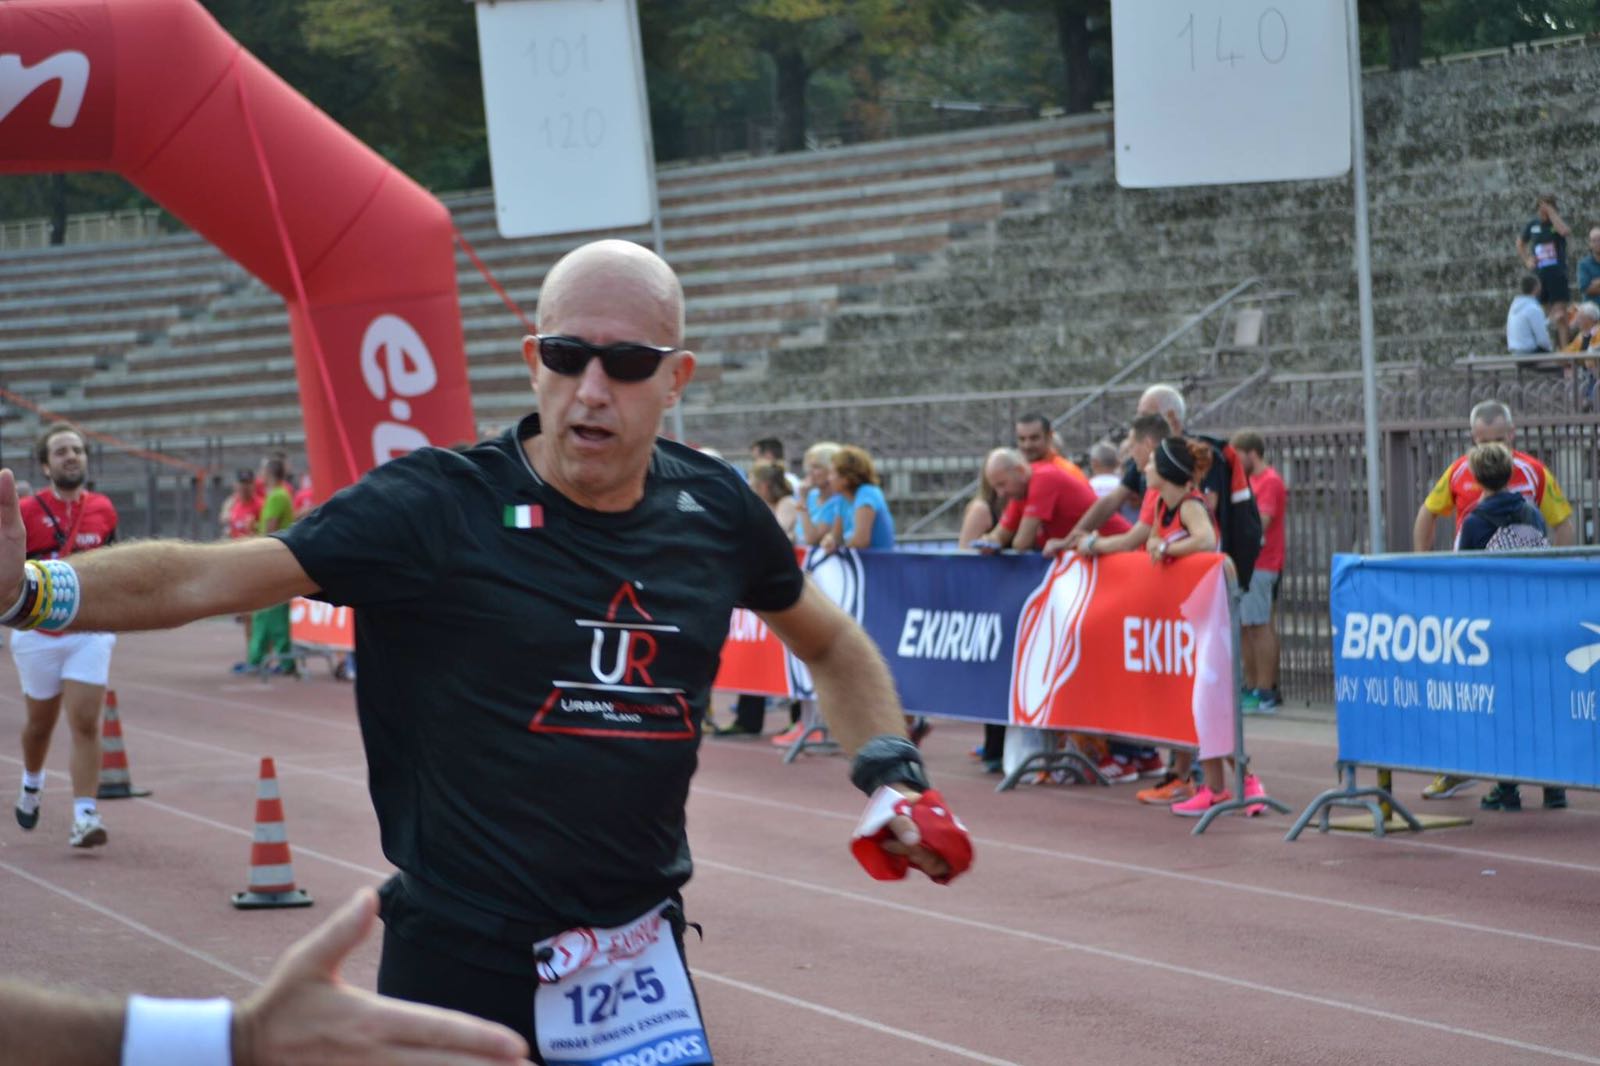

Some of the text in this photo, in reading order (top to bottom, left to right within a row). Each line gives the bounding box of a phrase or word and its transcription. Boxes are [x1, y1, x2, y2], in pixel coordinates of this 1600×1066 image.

[522, 33, 592, 78] 101
[1177, 6, 1289, 72] 140
[538, 107, 606, 149] 120
[590, 628, 659, 686] UR
[1340, 612, 1491, 667] BROOKS
[1364, 677, 1387, 706] YOU
[1427, 678, 1452, 711] RUN
[1570, 689, 1597, 721] LIVE
